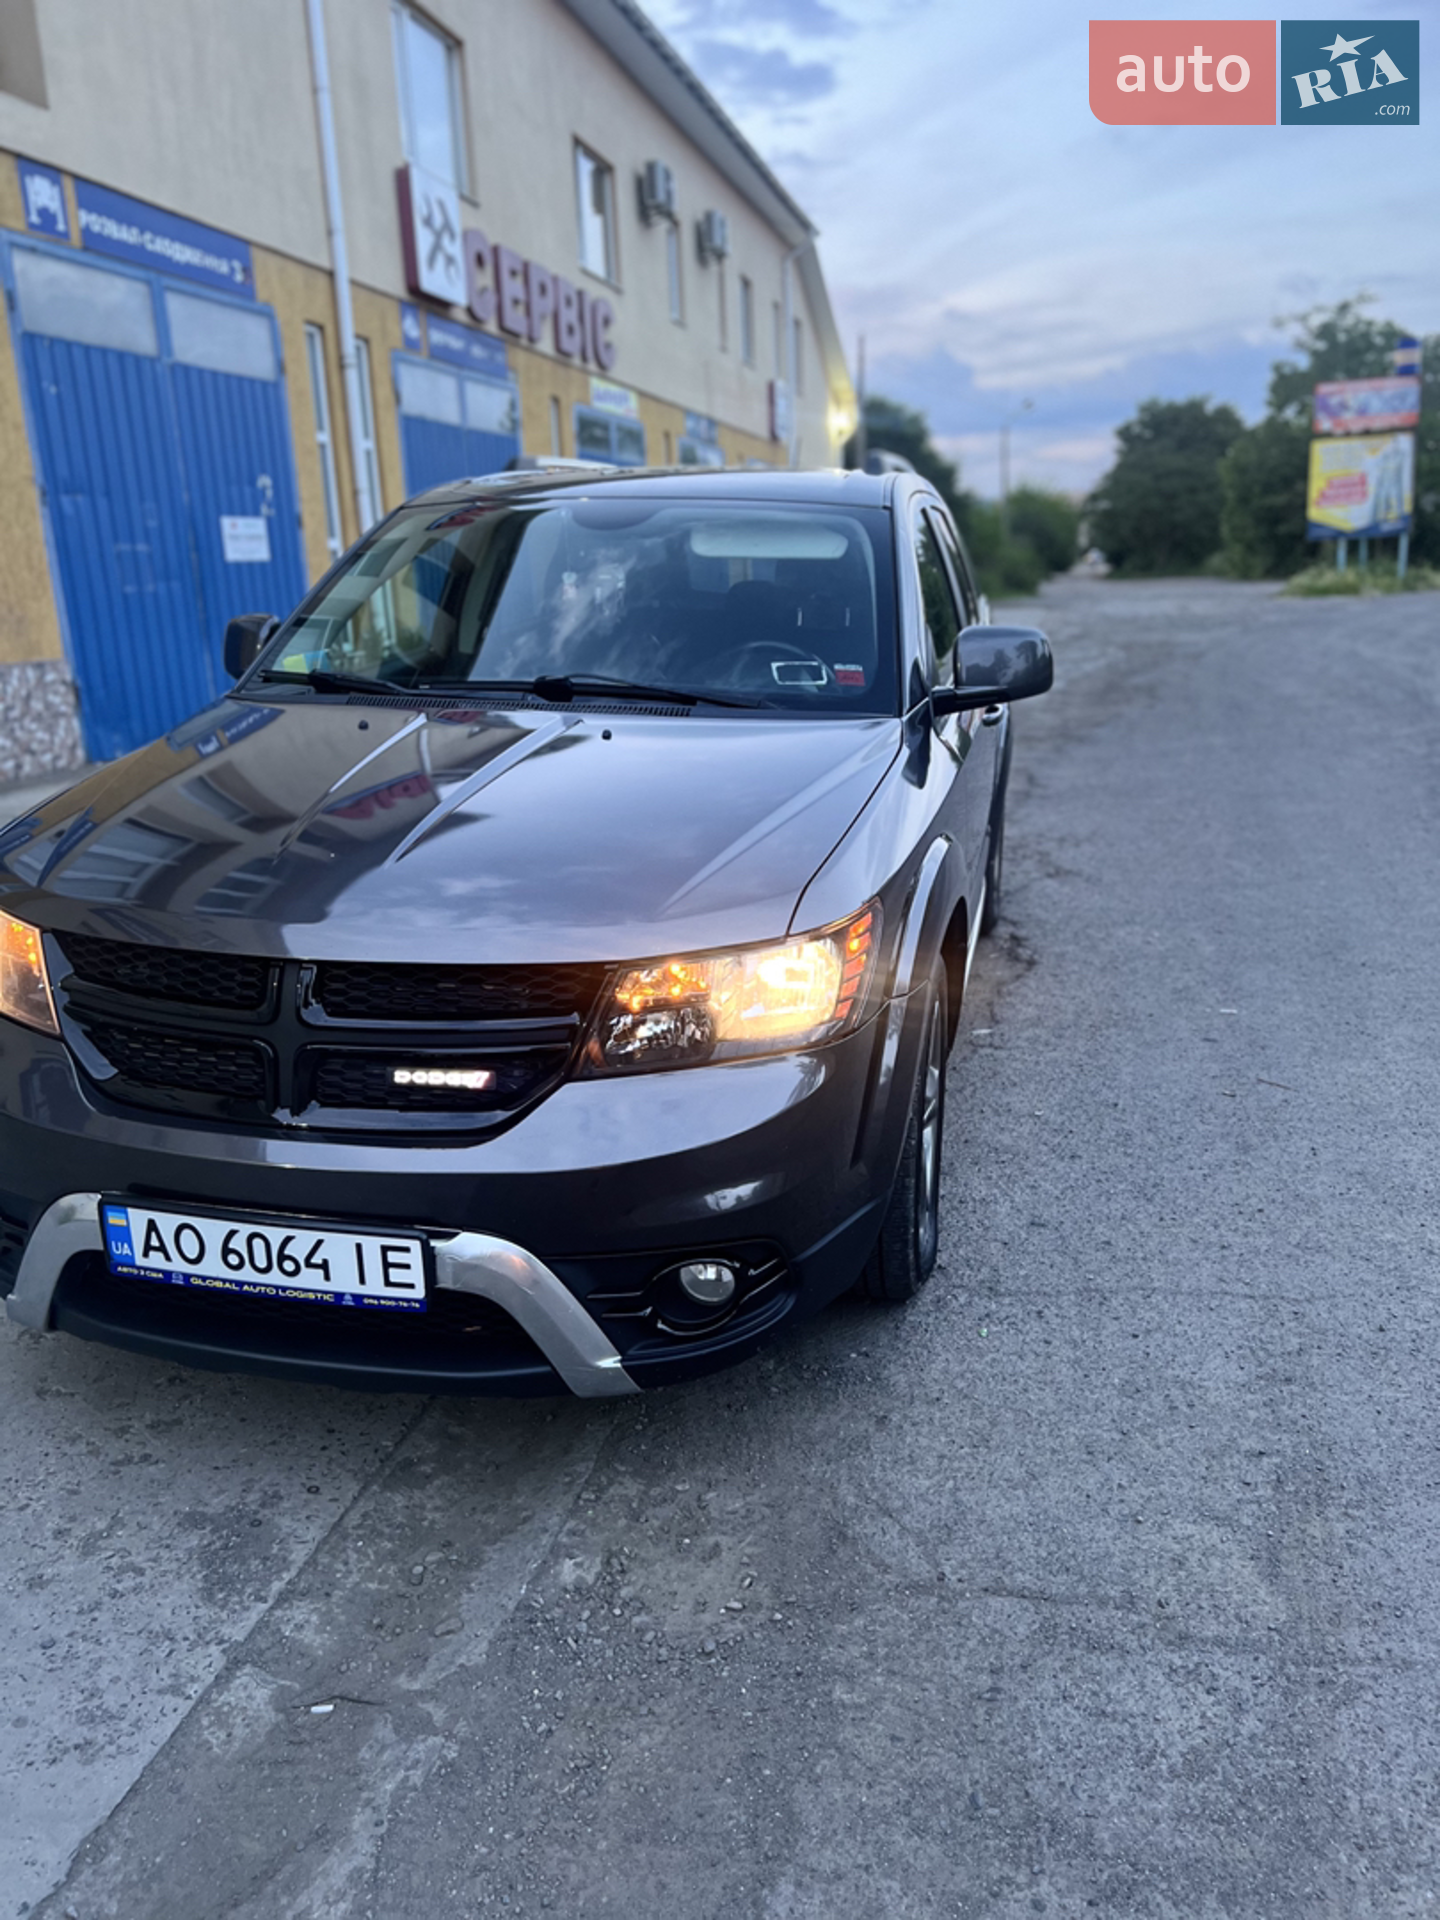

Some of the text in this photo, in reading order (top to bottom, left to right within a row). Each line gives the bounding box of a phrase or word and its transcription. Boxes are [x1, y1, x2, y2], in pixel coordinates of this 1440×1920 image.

[463, 228, 616, 372] СЕРВІС
[110, 1240, 132, 1257] UA
[141, 1217, 416, 1290] AO 6064 IE
[189, 1275, 335, 1302] GLOBAL AUTO LOGISTIC
